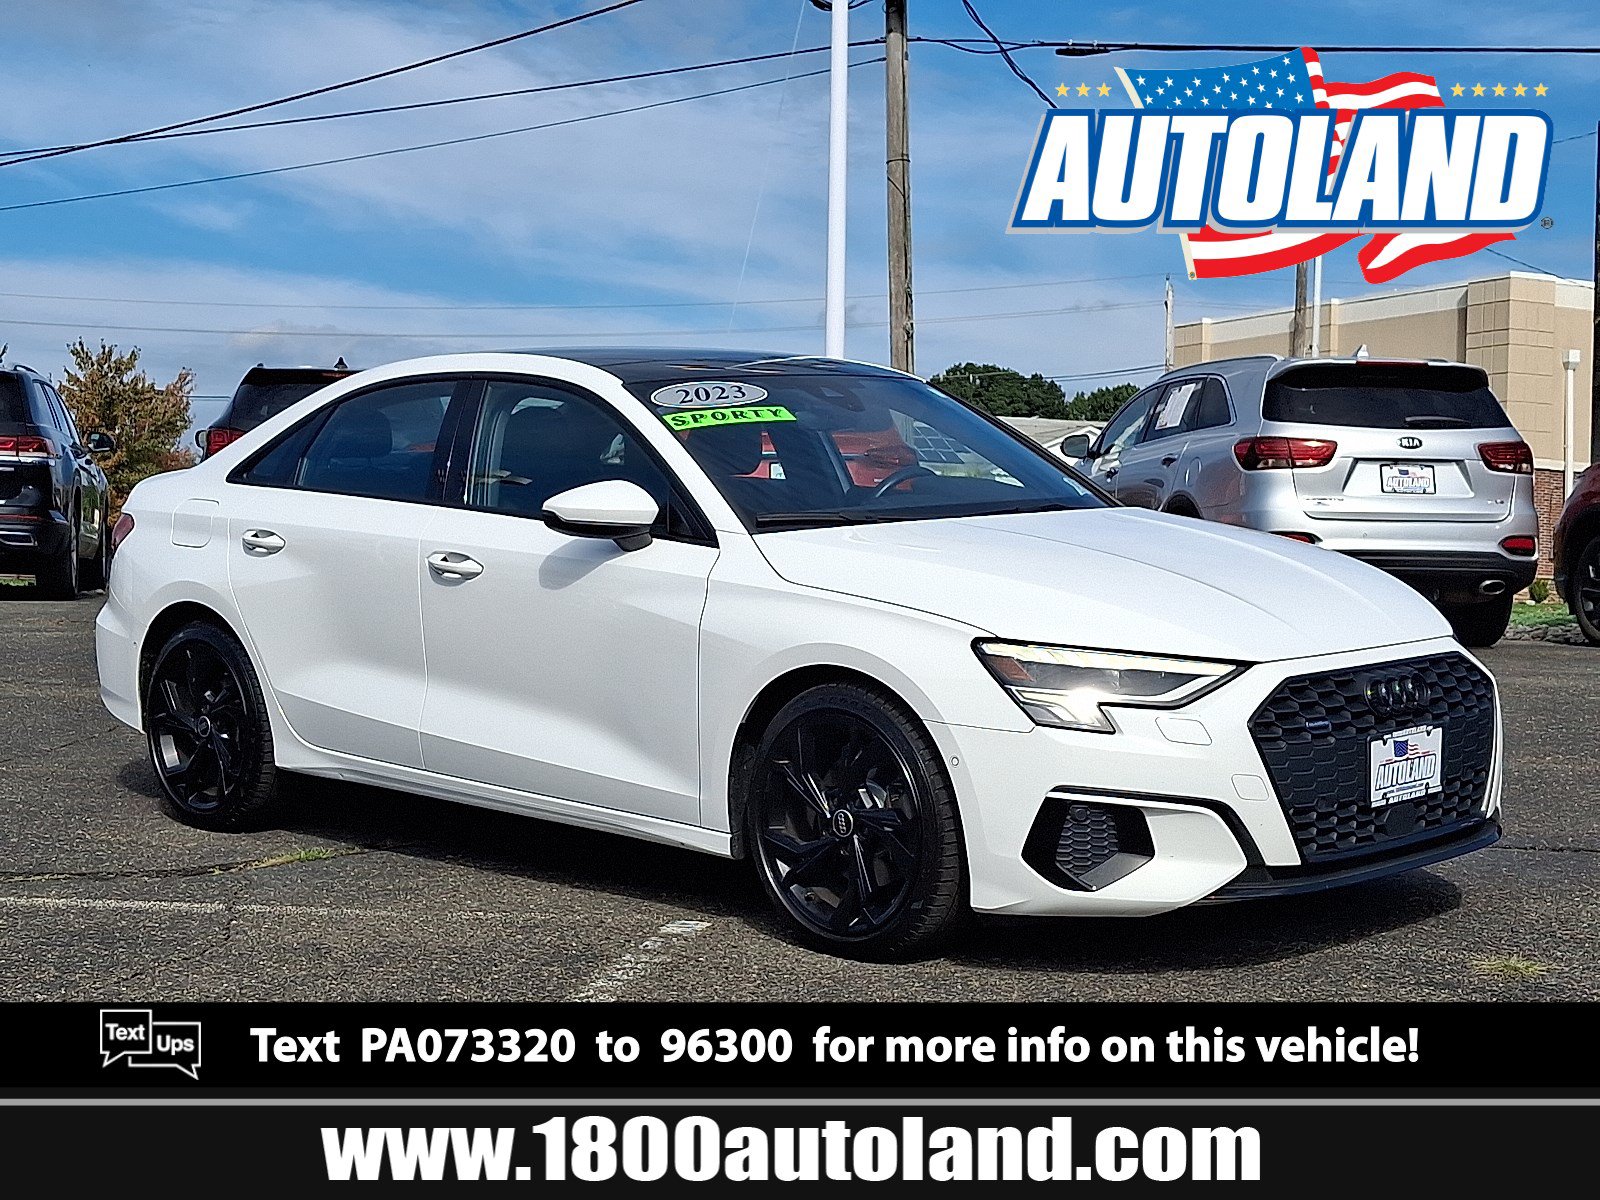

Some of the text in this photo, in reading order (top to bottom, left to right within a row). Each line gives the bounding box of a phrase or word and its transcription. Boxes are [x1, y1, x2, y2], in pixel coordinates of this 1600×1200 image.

[676, 386, 746, 404] 2023
[671, 409, 781, 426] SPORTY
[1375, 754, 1436, 791] AUTOLAND
